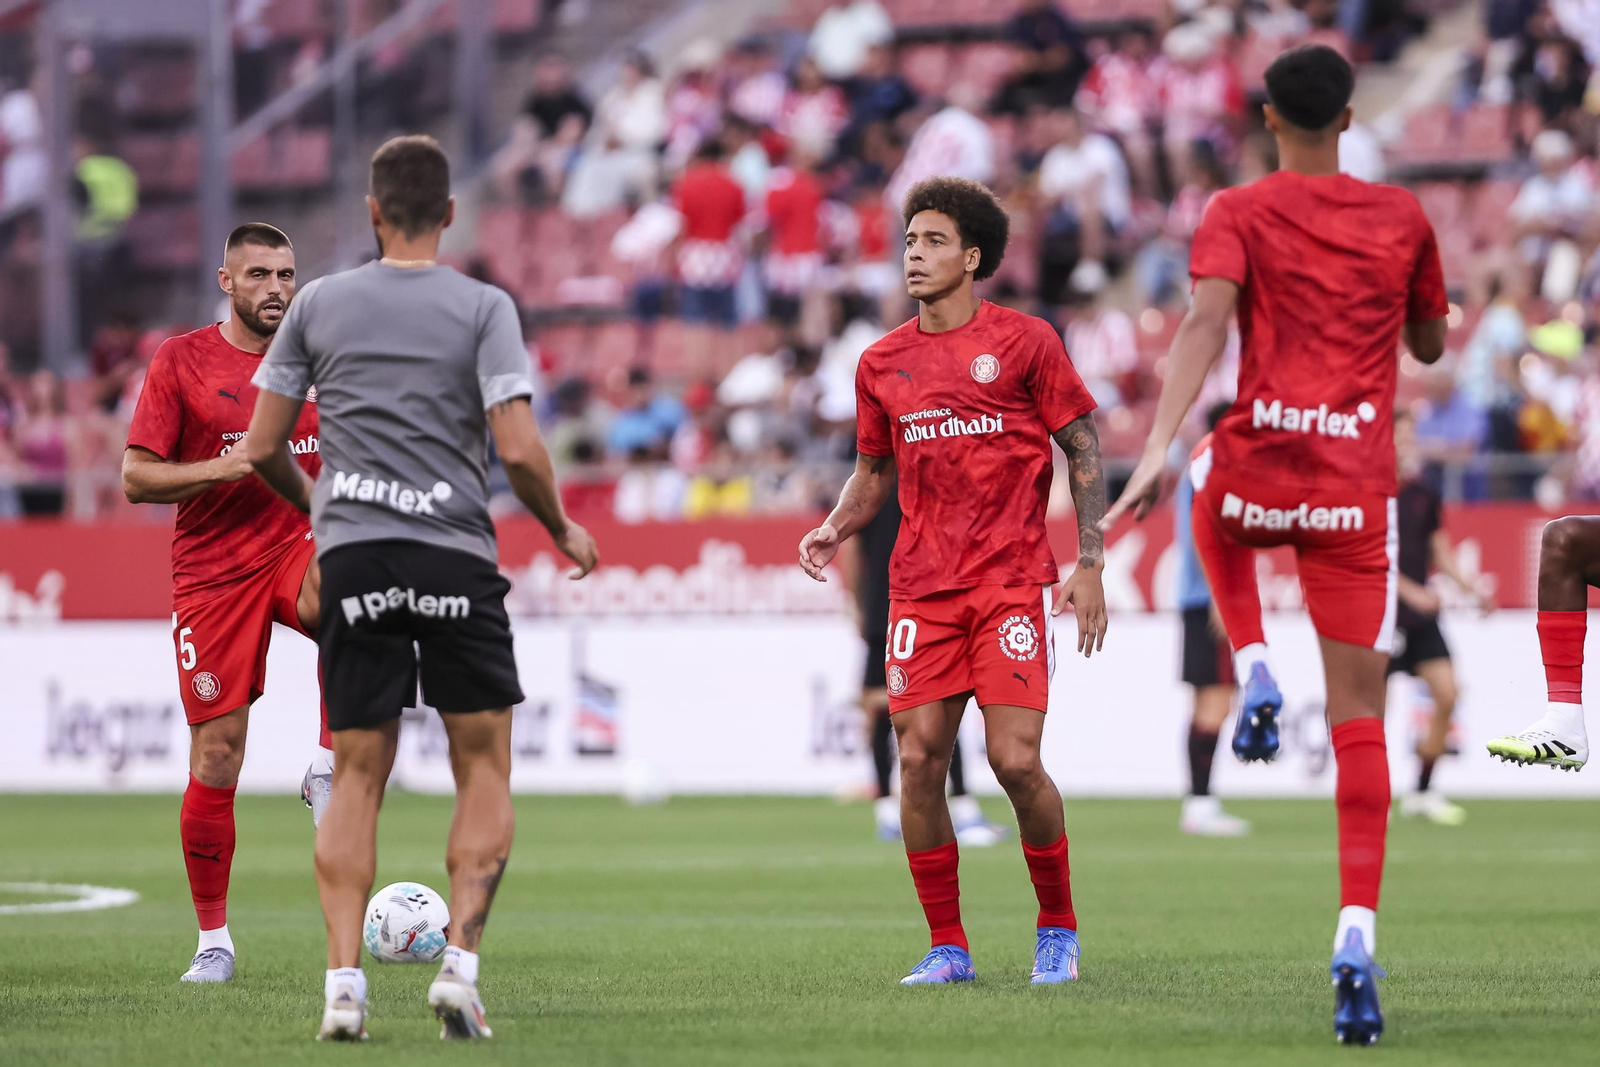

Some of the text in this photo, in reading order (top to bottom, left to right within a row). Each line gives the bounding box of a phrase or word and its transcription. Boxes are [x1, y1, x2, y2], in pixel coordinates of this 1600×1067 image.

[899, 407, 952, 423] experience
[904, 413, 1004, 443] abu dhabi
[1252, 398, 1360, 440] Marlex
[331, 471, 434, 515] Marlex
[1242, 502, 1364, 531] parlem
[362, 586, 470, 621] parlem
[998, 615, 1021, 634] Costa
[180, 626, 197, 671] 5
[998, 637, 1016, 660] Pirineu
